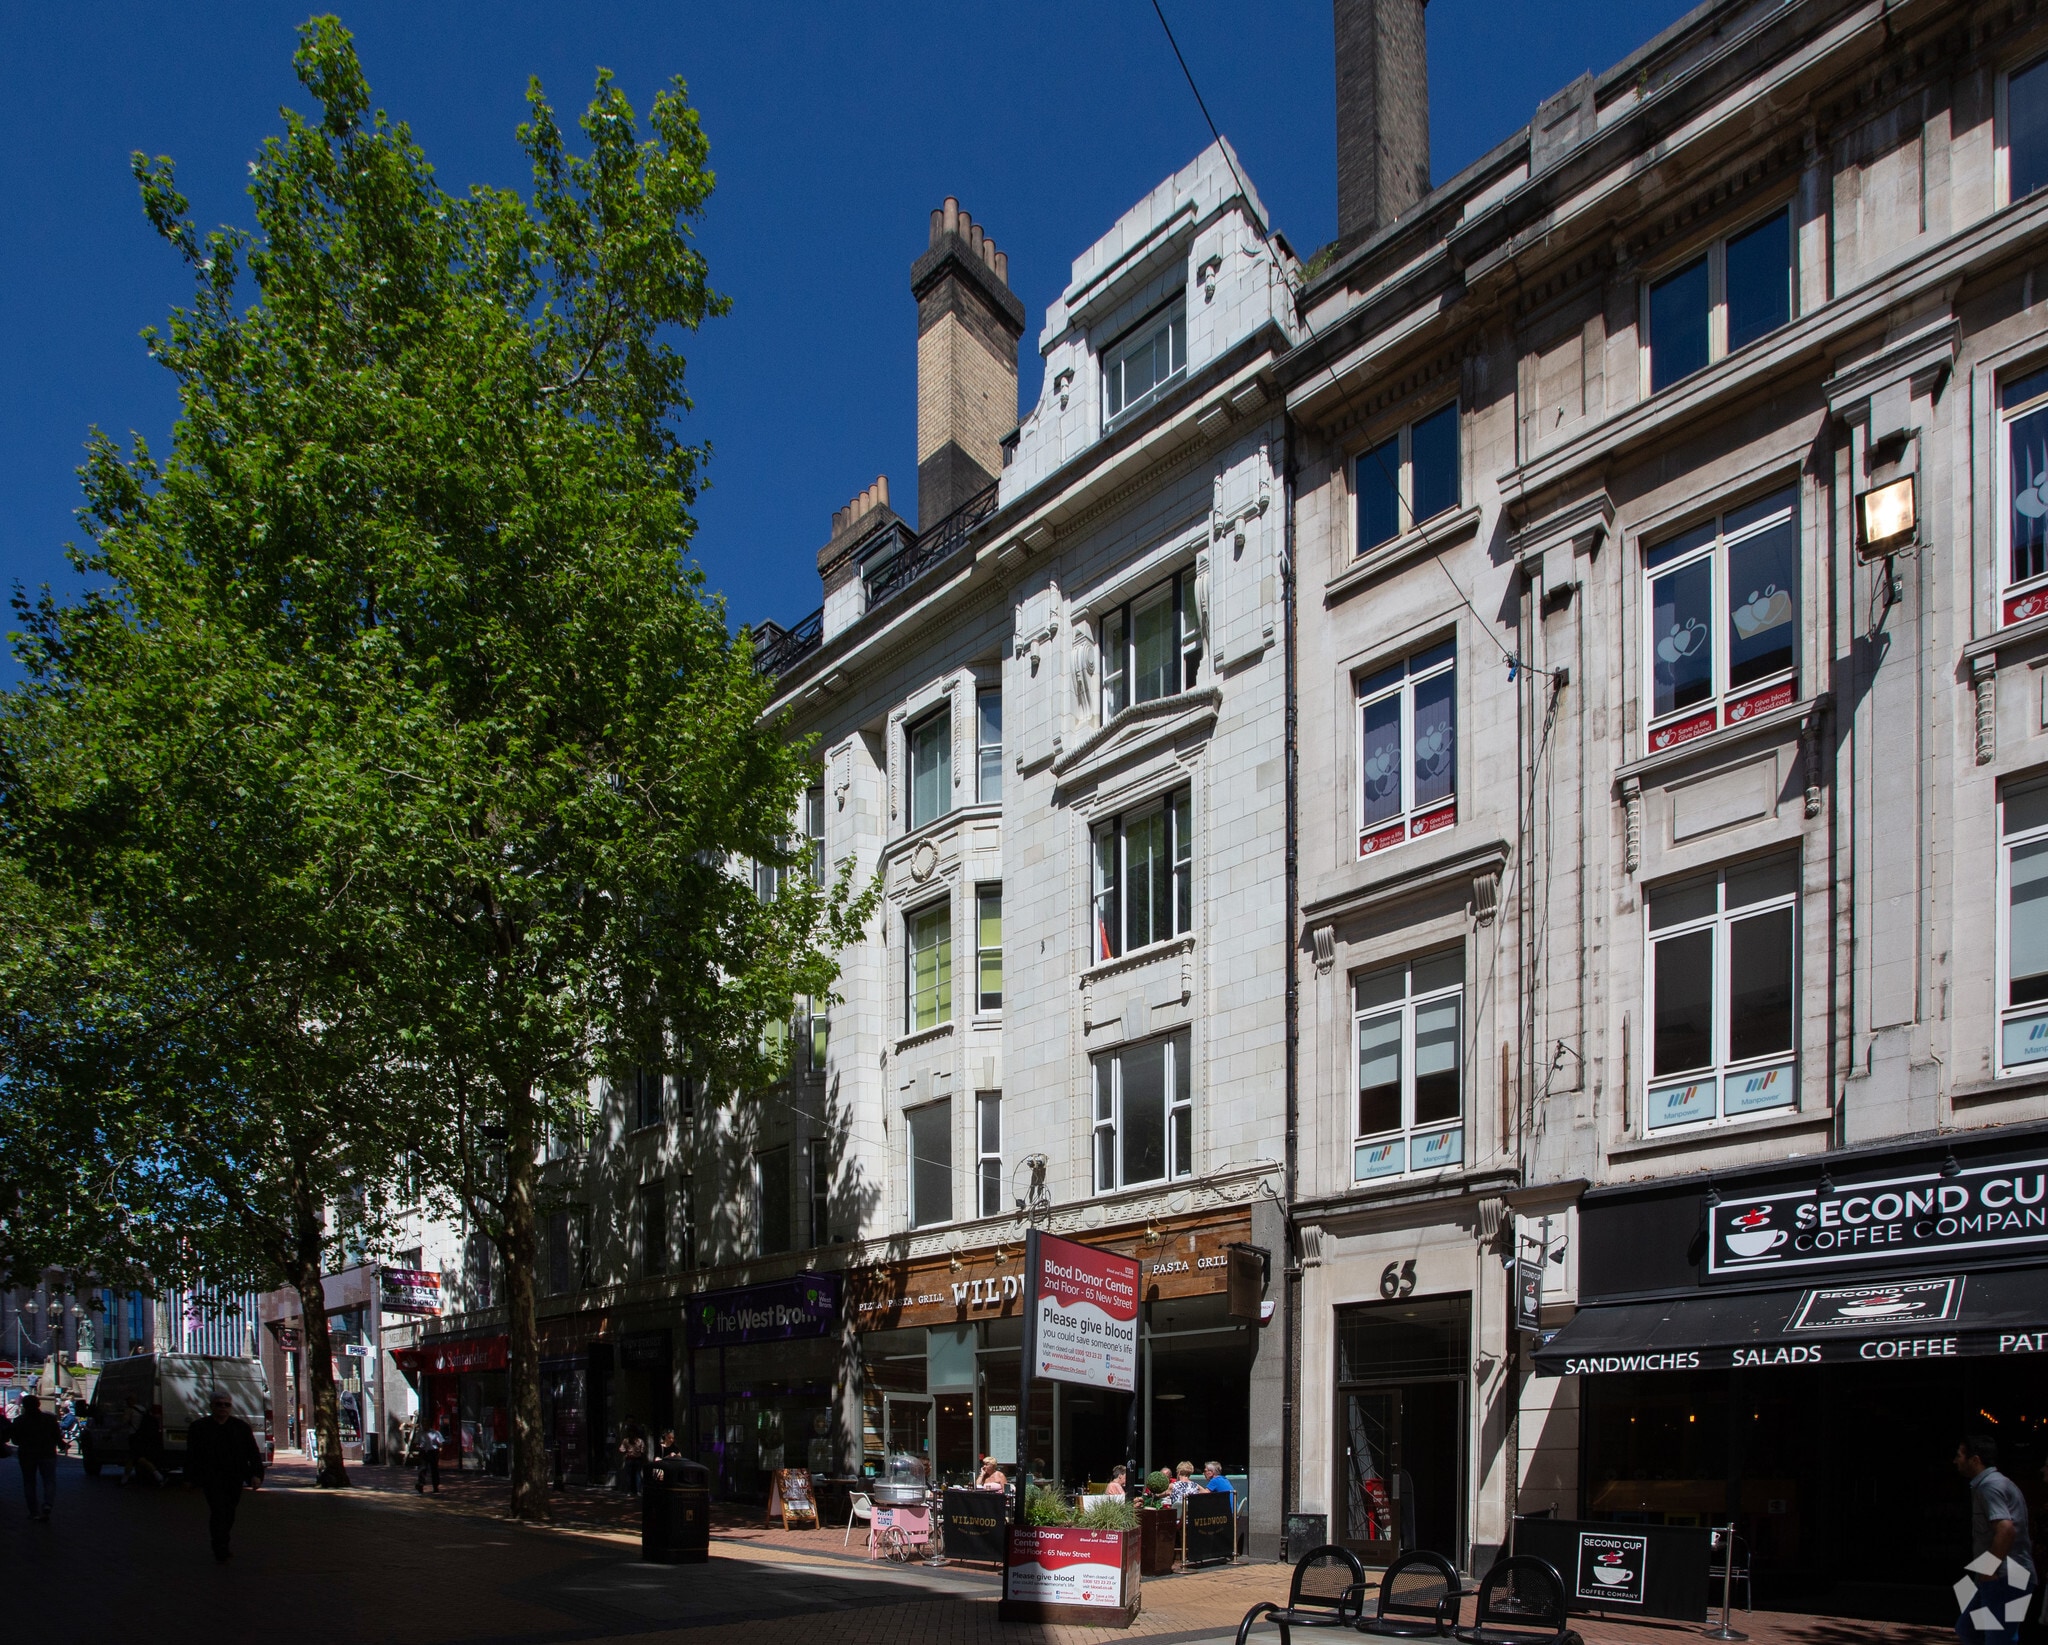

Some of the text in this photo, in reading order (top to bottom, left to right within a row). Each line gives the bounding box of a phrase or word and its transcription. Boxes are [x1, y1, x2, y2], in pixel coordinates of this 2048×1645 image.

[1754, 689, 1791, 708] Give blood
[1678, 727, 1693, 736] Save
[1678, 725, 1712, 742] Give blood
[1430, 815, 1440, 825] Give
[1379, 835, 1404, 849] Give blood
[1741, 1093, 1779, 1105] Manpower
[1664, 1108, 1699, 1120] Manpower
[1795, 1185, 1970, 1230] SECOND
[1794, 1207, 2048, 1252] COFFEE COMPAN
[1152, 1255, 1228, 1274] PASTA GRIL
[1044, 1259, 1133, 1296] Blood Donor Centre
[1380, 1259, 1417, 1299] 65
[425, 1288, 439, 1296] LET
[1044, 1276, 1059, 1291] 2nd
[1061, 1281, 1080, 1296] Floor
[1085, 1288, 1095, 1300] 65
[1095, 1290, 1112, 1304] New
[1113, 1295, 1133, 1310] Street
[1820, 1283, 1945, 1300] SECOND CUP
[887, 1296, 913, 1308] PASTA
[918, 1293, 944, 1304] GRILL
[716, 1311, 736, 1334] the
[736, 1306, 774, 1330] West
[1043, 1307, 1133, 1341] Please give blood
[1864, 1313, 1936, 1322] COMPANY
[1043, 1329, 1133, 1355] you could save someone's life
[1860, 1337, 1958, 1359] COFFEE
[447, 1348, 488, 1368] Santander
[1564, 1351, 1700, 1375] SANDWICHES
[1731, 1345, 1822, 1367] SALADS
[988, 1404, 1017, 1412] WILDWOOD
[951, 1514, 997, 1527] WILDWOOD
[1194, 1515, 1228, 1528] WILDWOOD
[1014, 1530, 1064, 1540] Blood Donor
[1014, 1538, 1040, 1547] Centre
[1583, 1538, 1642, 1550] SECOND CUP
[1026, 1547, 1042, 1556] Floor
[1072, 1550, 1091, 1558] Street
[1012, 1571, 1075, 1582] Please give blood
[1580, 1588, 1639, 1599] COFFEE COMPANY
